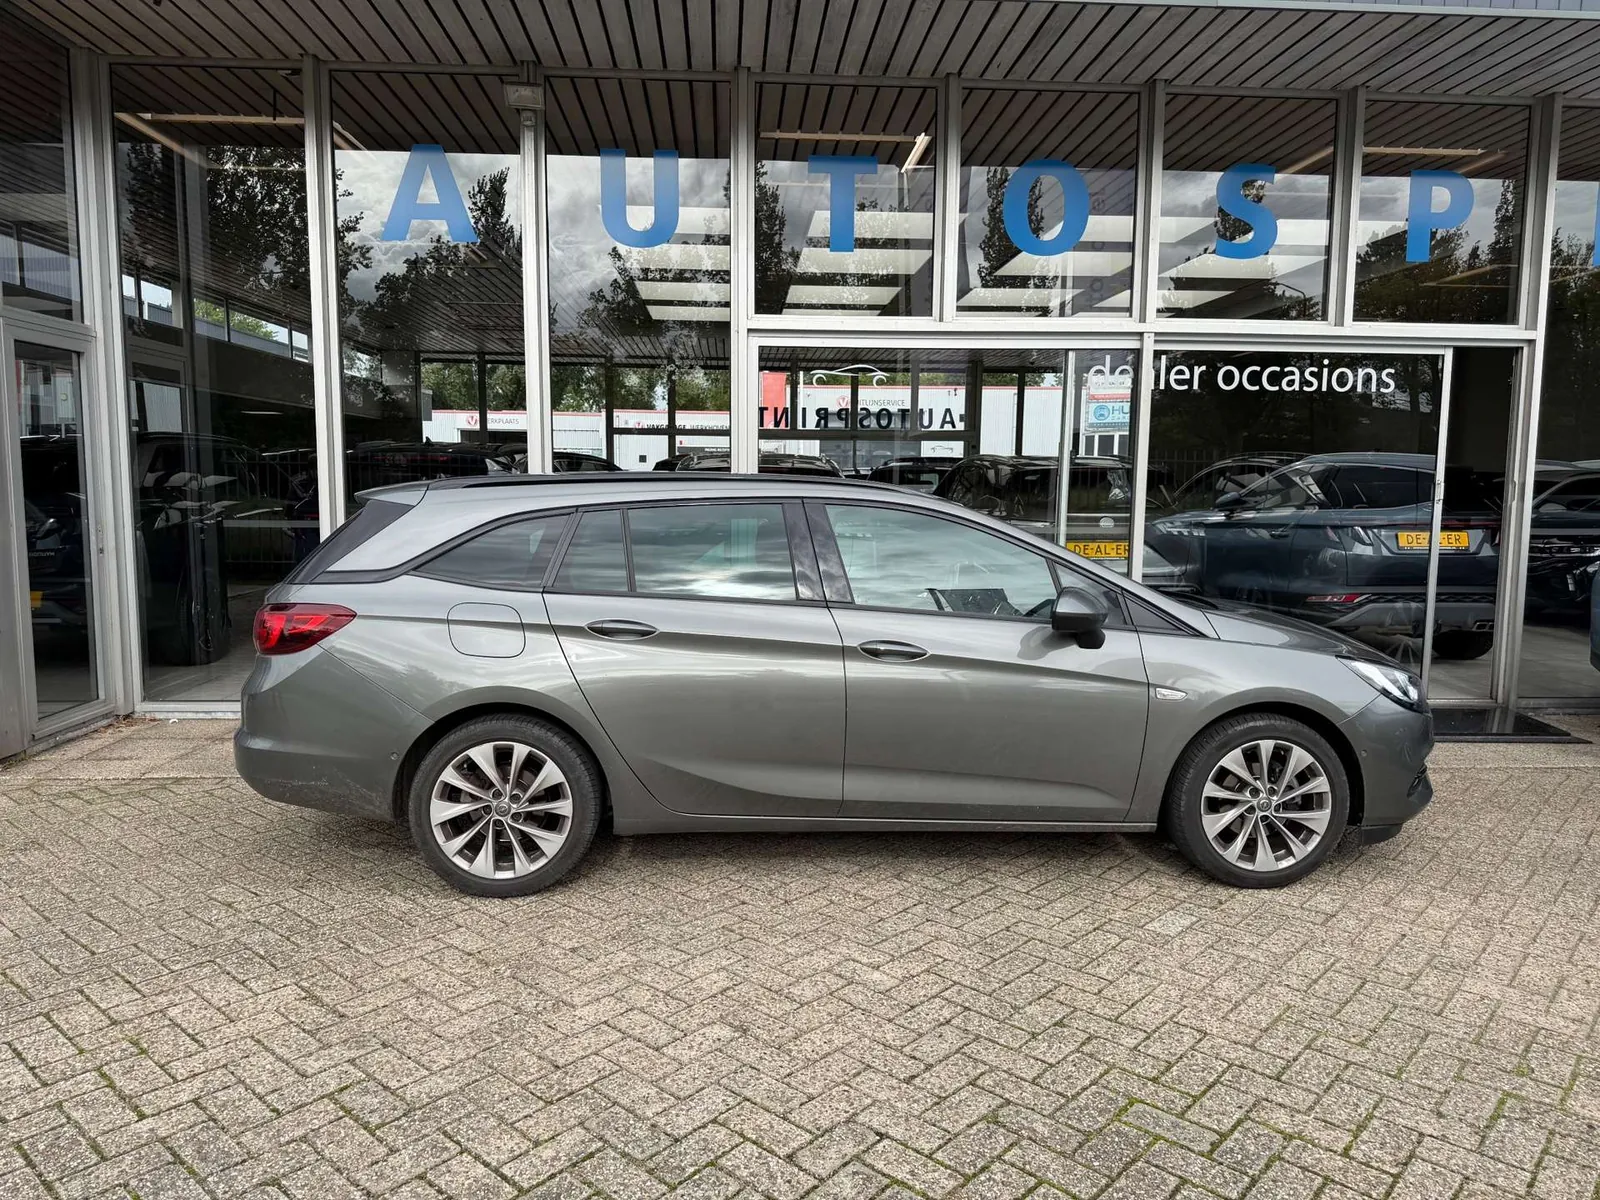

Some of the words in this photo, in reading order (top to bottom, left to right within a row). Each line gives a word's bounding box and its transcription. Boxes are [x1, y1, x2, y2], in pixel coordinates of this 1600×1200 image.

[1087, 355, 1206, 391] deler
[1217, 358, 1396, 394] occasions
[487, 417, 520, 425] ERKPLAATS
